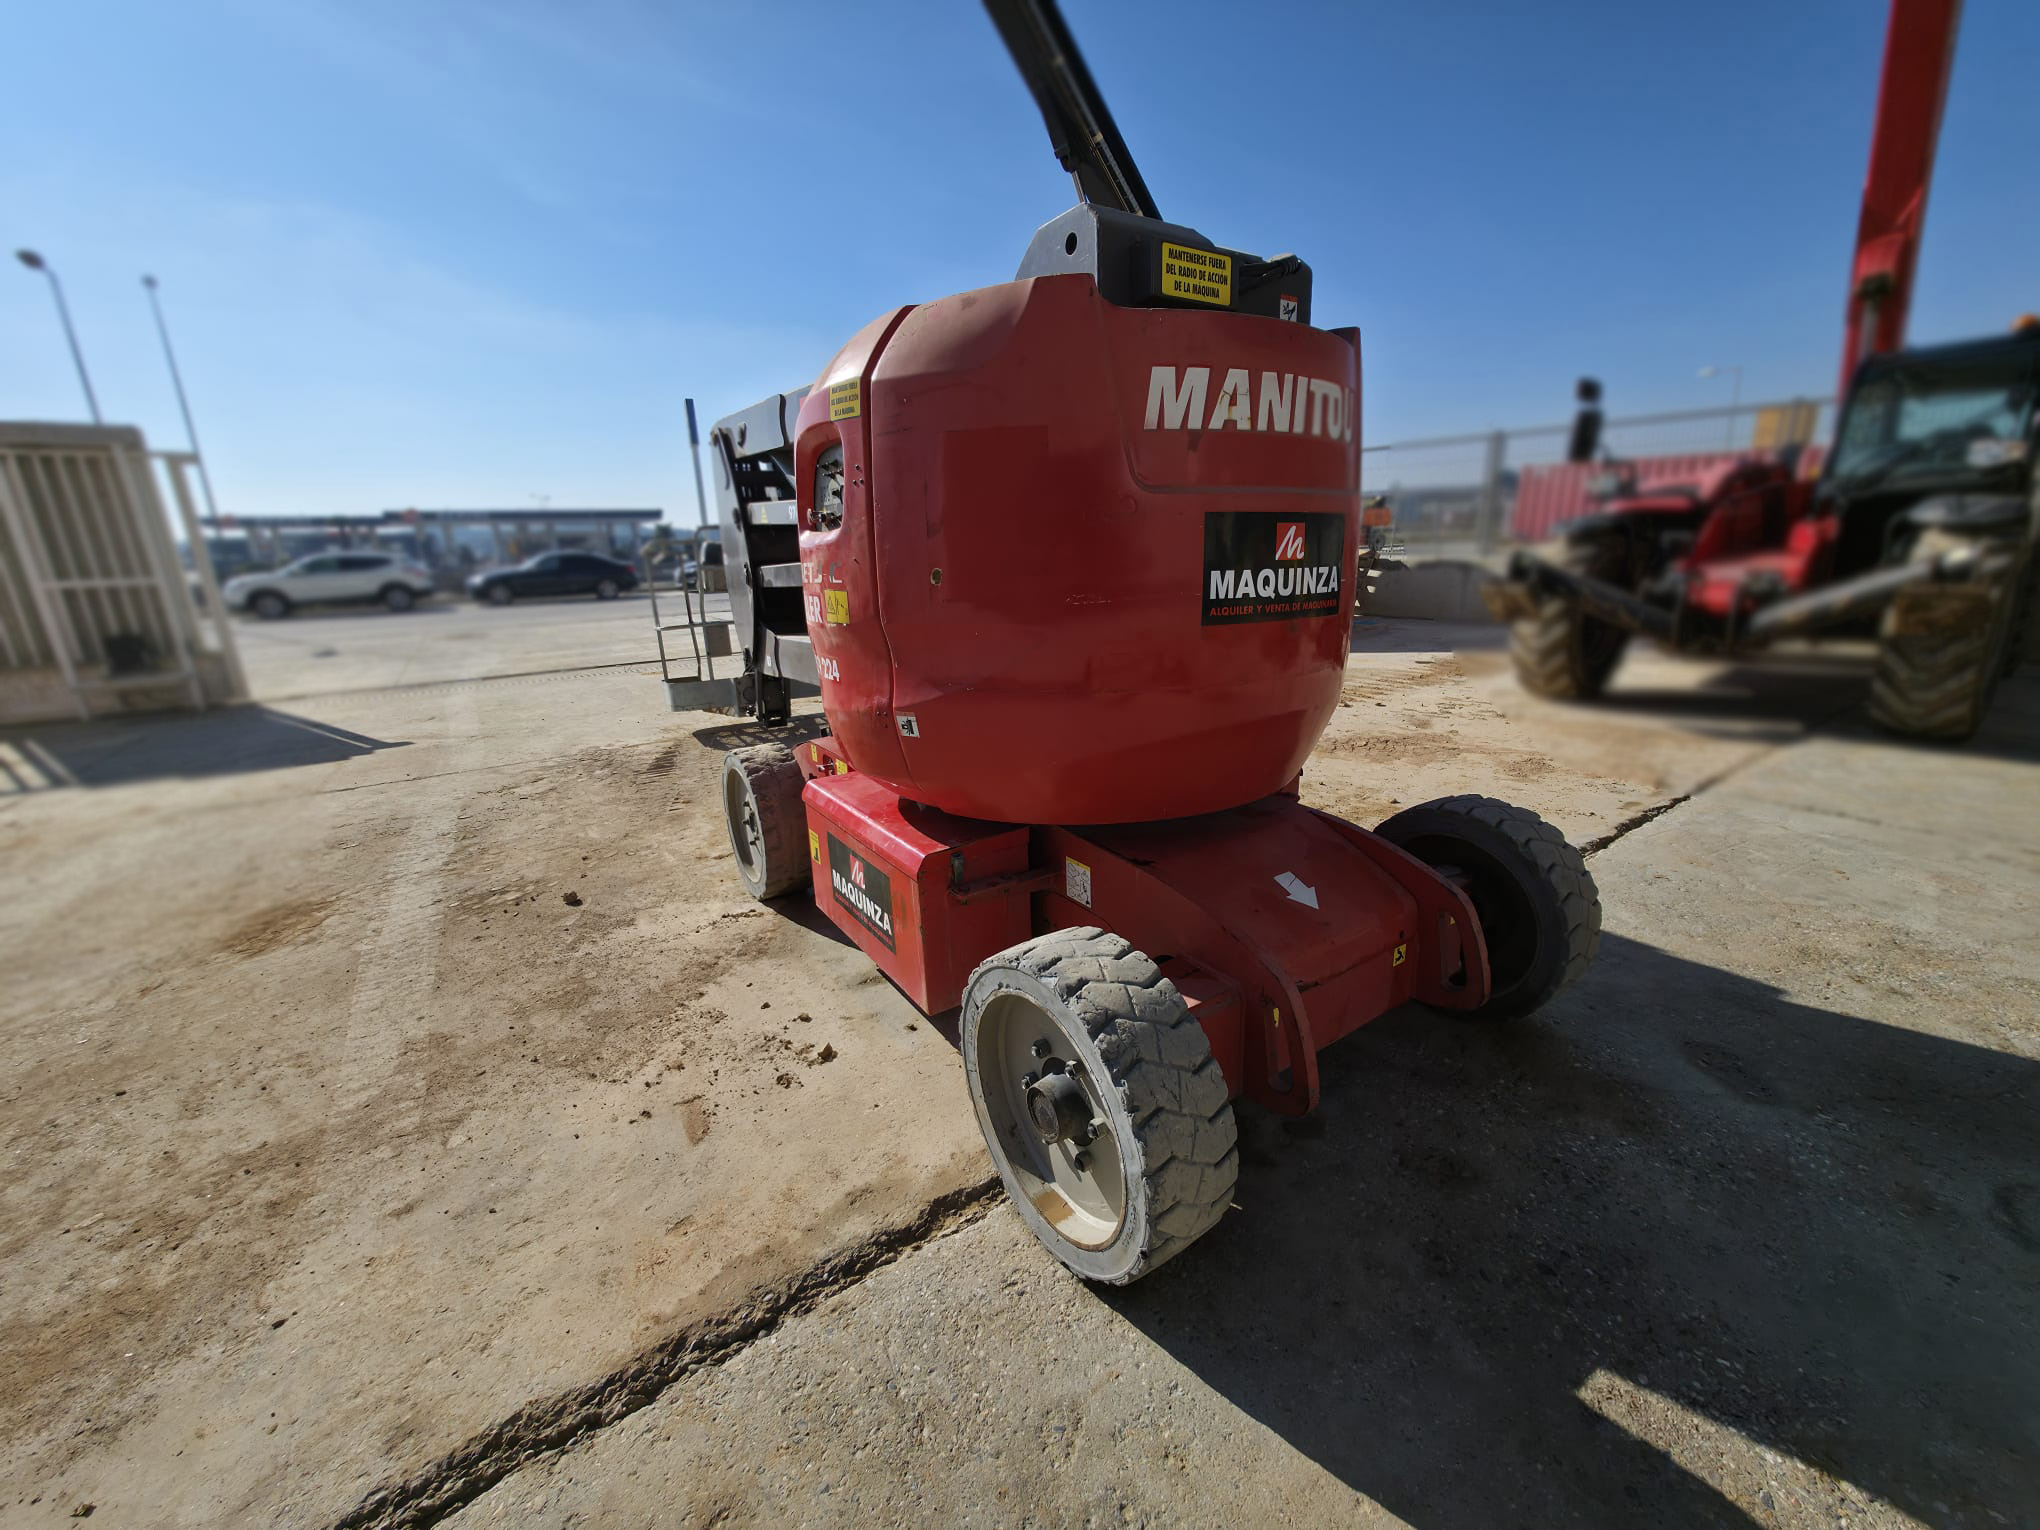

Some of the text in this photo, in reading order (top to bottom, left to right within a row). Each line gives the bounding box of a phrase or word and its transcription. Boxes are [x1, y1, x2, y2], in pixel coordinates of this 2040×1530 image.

[1168, 248, 1226, 270] MANTENERSE FUERA
[1166, 262, 1176, 275] DEL
[1178, 266, 1197, 279] RADIO
[1199, 269, 1206, 281] DE
[1174, 280, 1182, 292] DE
[1183, 281, 1191, 293] LA
[1209, 566, 1339, 600] MAQUINZA
[1210, 605, 1253, 616] ALQUILER
[1256, 605, 1263, 613] Y
[1264, 603, 1290, 612] VENTA
[1292, 602, 1301, 610] DE
[832, 869, 893, 936] MAQUINZA
